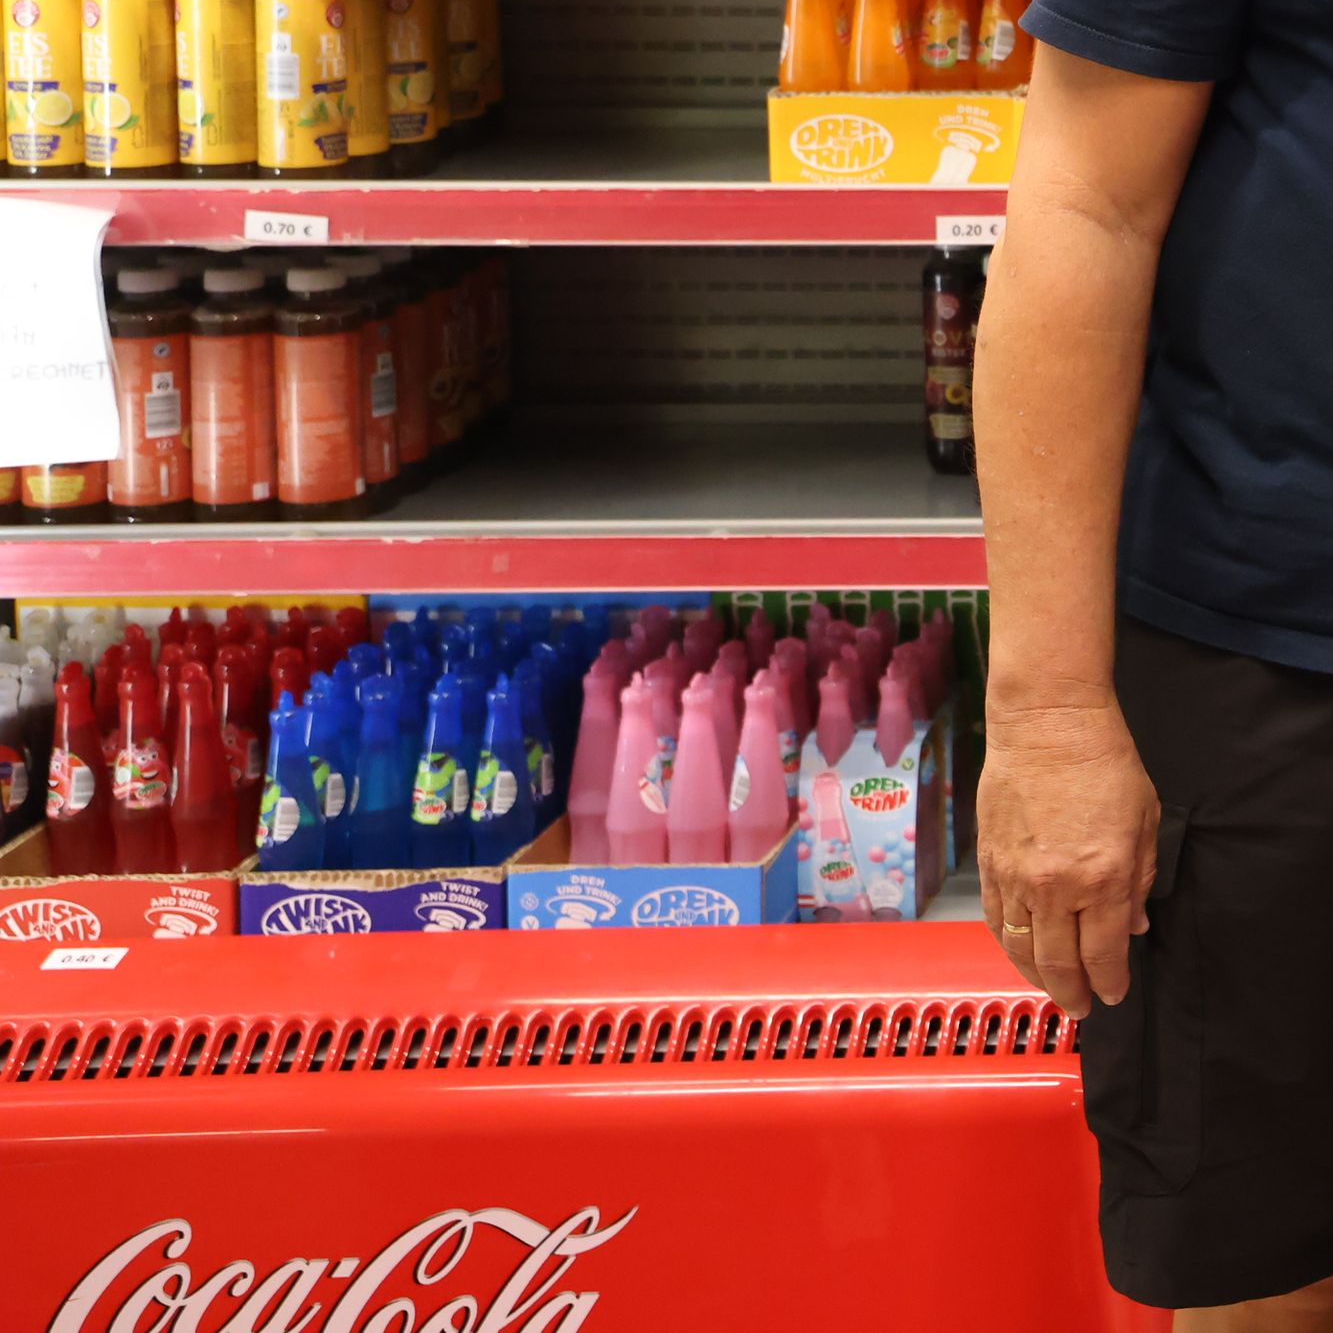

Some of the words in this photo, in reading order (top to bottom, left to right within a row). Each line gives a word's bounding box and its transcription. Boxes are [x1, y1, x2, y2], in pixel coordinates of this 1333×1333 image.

[263, 221, 296, 236] 0.70
[303, 224, 313, 237] €
[952, 224, 983, 237] 0.20
[990, 224, 998, 237] €
[441, 881, 481, 897] TWIST
[569, 875, 605, 887] DREH
[170, 886, 211, 902] TWIST
[556, 886, 582, 896] UND
[151, 897, 177, 908] AND
[179, 898, 219, 916] DRINK!
[421, 891, 447, 903] AND
[448, 892, 489, 912] DRINK!
[265, 897, 360, 932] TWIST
